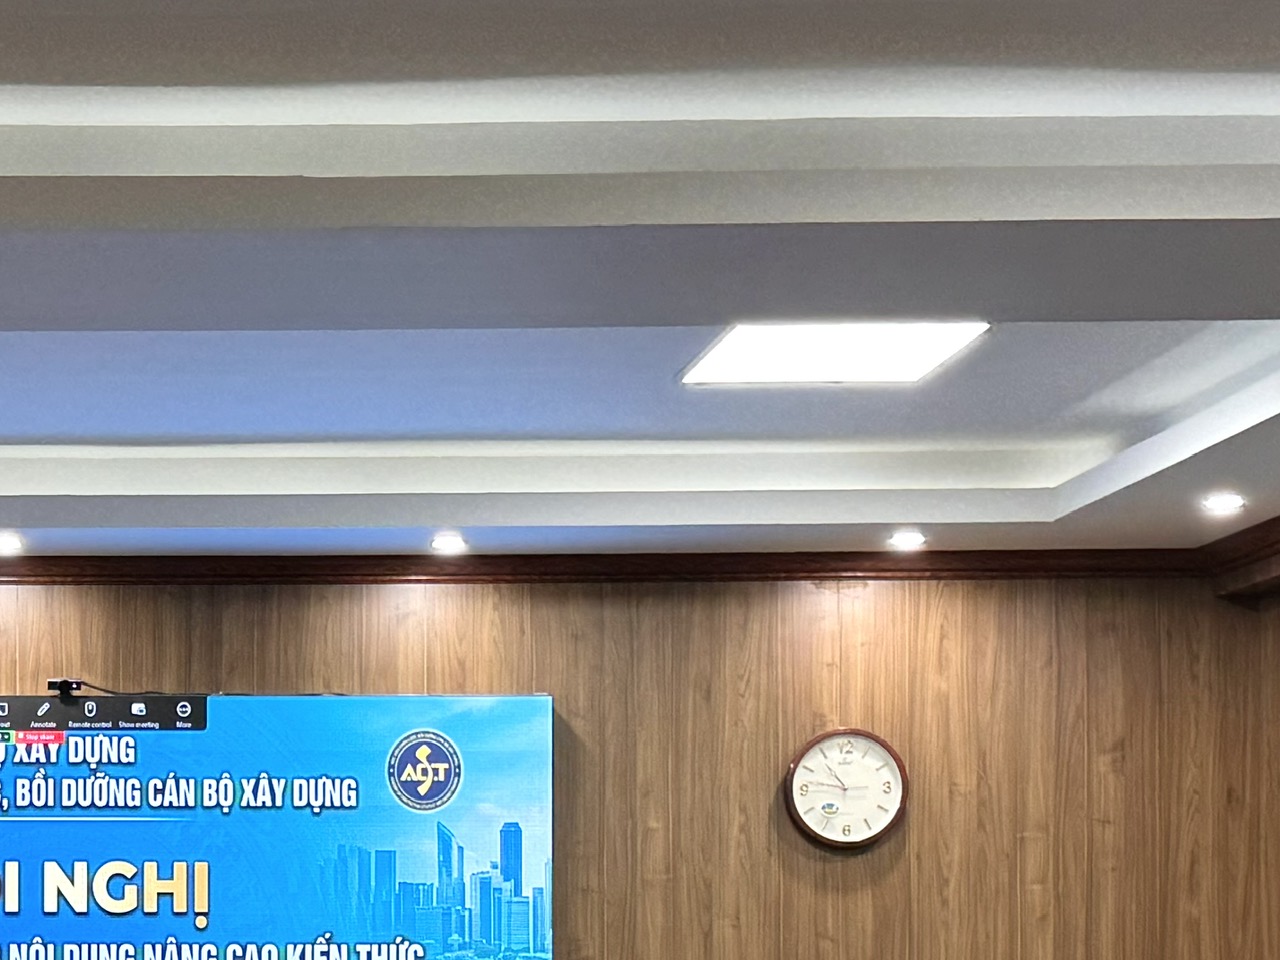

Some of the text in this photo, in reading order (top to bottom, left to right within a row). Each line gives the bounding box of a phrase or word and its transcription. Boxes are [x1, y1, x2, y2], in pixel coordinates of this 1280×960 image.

[30, 720, 57, 728] Annotate
[68, 720, 112, 728] Remote control
[119, 720, 160, 729] Show meeting
[176, 720, 192, 728] More
[68, 734, 135, 769] DỰNG
[837, 739, 854, 755] 12
[16, 767, 55, 807] BỒI
[61, 772, 142, 807] DƯỠNG
[147, 772, 195, 807] CÁN
[203, 772, 234, 813] BỘ
[240, 772, 287, 807] XÂY
[293, 775, 358, 813] DỰNG
[799, 784, 809, 796] 9
[882, 781, 891, 794] 3
[842, 824, 851, 837] 6
[43, 860, 209, 929] NGHỊ
